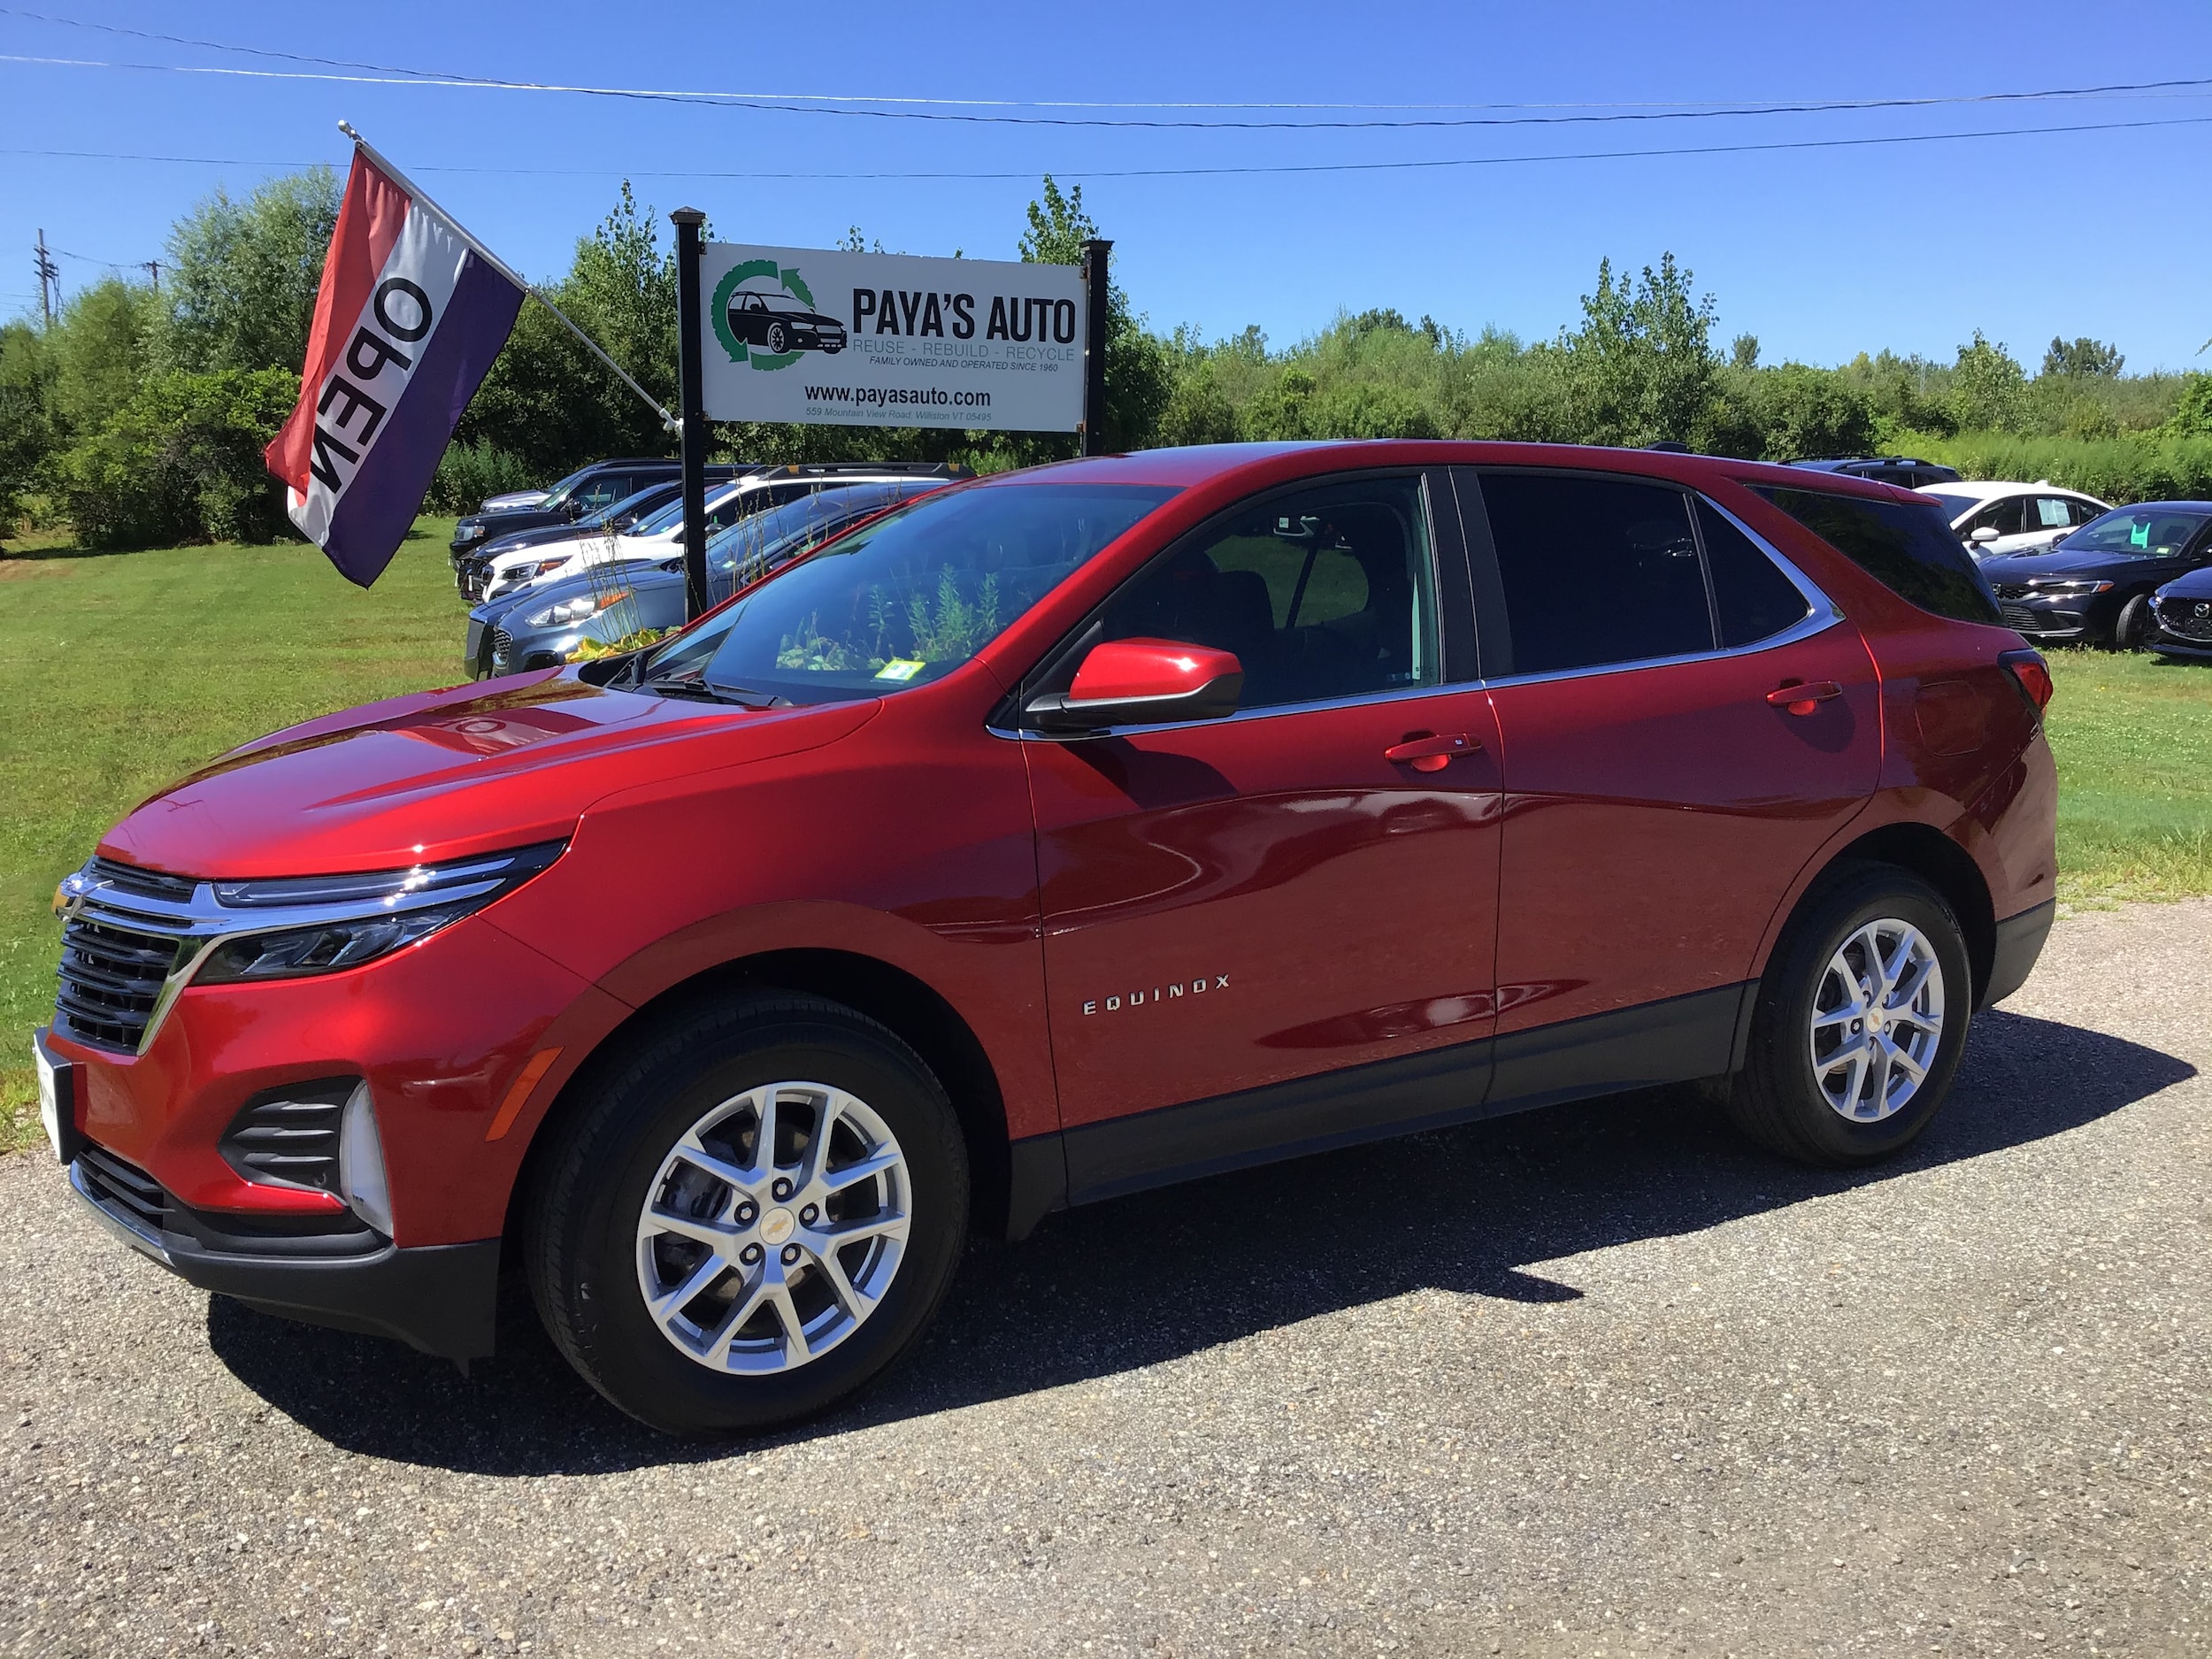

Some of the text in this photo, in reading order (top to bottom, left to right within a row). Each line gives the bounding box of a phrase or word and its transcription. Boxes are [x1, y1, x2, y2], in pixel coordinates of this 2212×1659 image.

[853, 288, 1076, 344] PAYA'S AUTO
[853, 339, 905, 354] REUSE
[923, 342, 989, 357] REBUILD
[1006, 346, 1075, 361] RECYCLE
[869, 356, 1058, 372] FAMILY OWNED AND OPERATED SINCE 1960
[804, 385, 991, 407] www.payasauto.com
[806, 407, 822, 416] 559
[824, 408, 864, 418] Mountain
[866, 409, 886, 419] View
[916, 411, 949, 420] Williston
[952, 411, 964, 421] VT
[965, 412, 992, 422] 05495
[1083, 974, 1230, 1015] EQUINOX
